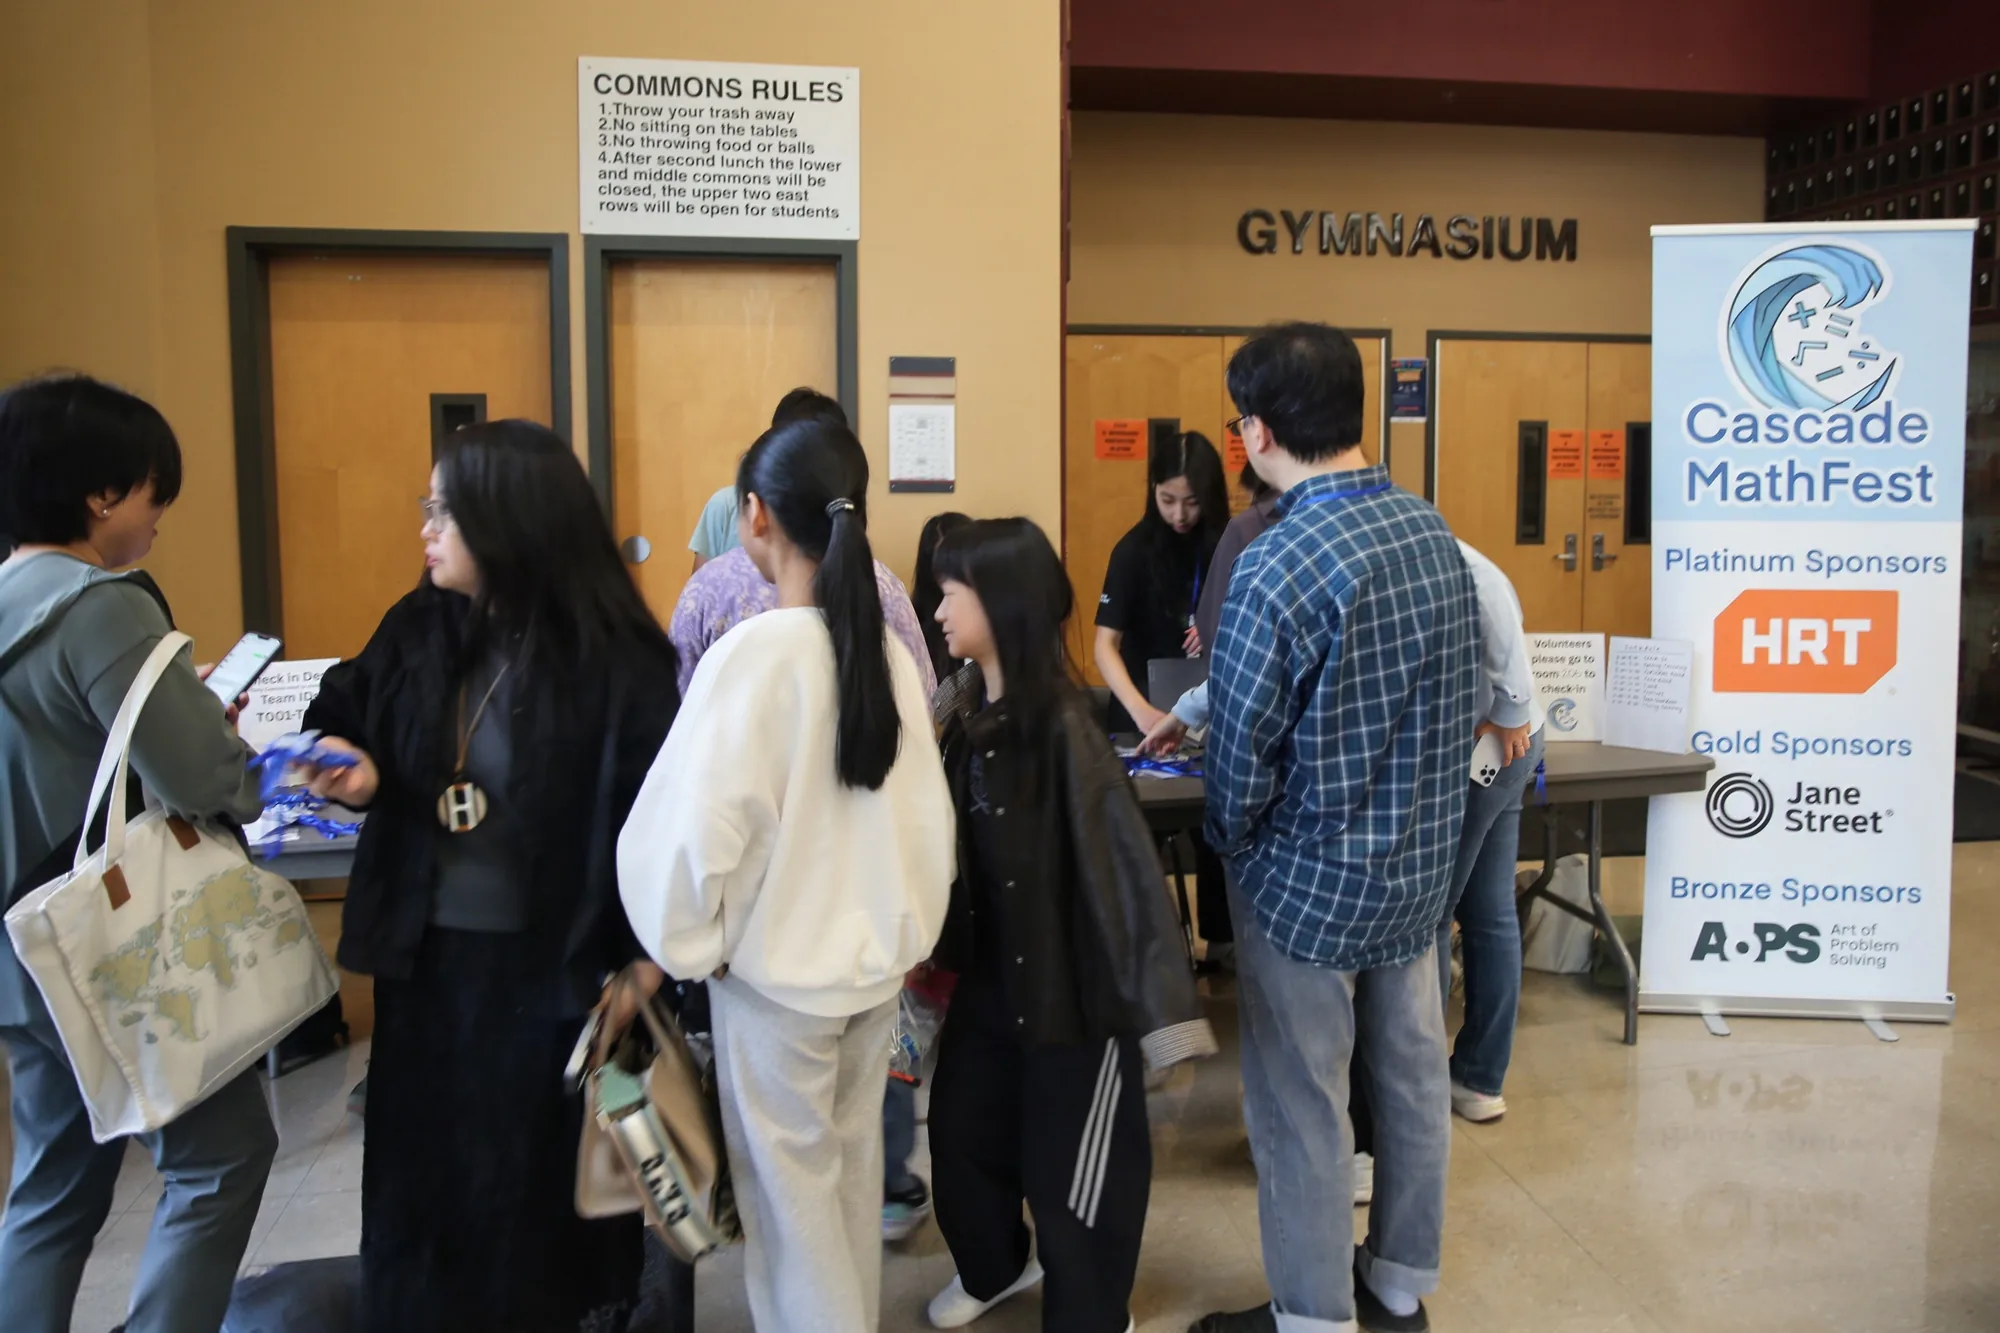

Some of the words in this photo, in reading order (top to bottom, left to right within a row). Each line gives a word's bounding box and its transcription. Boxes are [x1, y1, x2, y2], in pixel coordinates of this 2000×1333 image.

[594, 73, 742, 99] COMMONS
[753, 79, 843, 103] RULES
[600, 102, 663, 116] 1.Throw
[669, 108, 704, 121] your
[710, 107, 749, 119] trash
[755, 110, 794, 124] away
[599, 117, 635, 131] 2.No
[641, 120, 690, 137] sitting
[696, 125, 715, 134] on
[721, 123, 745, 136] the
[751, 125, 797, 138] tables
[599, 133, 634, 147] 3.No
[641, 136, 710, 153] throwing
[716, 138, 751, 151] food
[757, 143, 772, 152] or
[779, 141, 814, 154] balls
[598, 151, 652, 164] 4.After
[658, 155, 715, 167] second
[722, 156, 764, 168] lunch
[770, 157, 794, 170] the
[800, 158, 841, 171] lower
[598, 168, 628, 180] and
[634, 168, 687, 182] middle
[693, 173, 770, 185] commons
[776, 174, 801, 186] will
[808, 174, 826, 186] be
[598, 183, 656, 198] closed,
[662, 184, 686, 197] the
[692, 189, 738, 202] upper
[744, 188, 770, 200] two
[776, 190, 808, 201] east
[600, 201, 638, 212] rows
[644, 201, 670, 213] will
[676, 201, 694, 214] be
[700, 205, 739, 218] open
[745, 204, 766, 216] for
[772, 205, 839, 218] students
[1236, 208, 1579, 262] GYMNASIUM
[1686, 400, 1928, 444] Cascade
[1688, 460, 1933, 502] MathFest
[1664, 547, 1796, 573] Platinum
[1805, 548, 1948, 580] Sponsors
[1534, 639, 1592, 649] Volunteers
[1741, 617, 1871, 666] HRT
[1531, 654, 1566, 666] please
[1568, 655, 1581, 666] go
[1583, 654, 1595, 664] to
[253, 672, 285, 686] heck
[287, 672, 299, 683] in
[1584, 669, 1596, 679] to
[1540, 683, 1586, 694] check-in
[260, 694, 296, 705] Team
[1691, 730, 1761, 754] Gold
[1770, 730, 1913, 761] Sponsors
[1787, 781, 1861, 806] Jane
[1669, 875, 1773, 901] Bronze
[1781, 877, 1923, 908] Sponsors
[1830, 923, 1856, 936] Art
[1860, 923, 1878, 936] of
[1830, 938, 1900, 952] Problem
[1829, 952, 1887, 969] Solving
